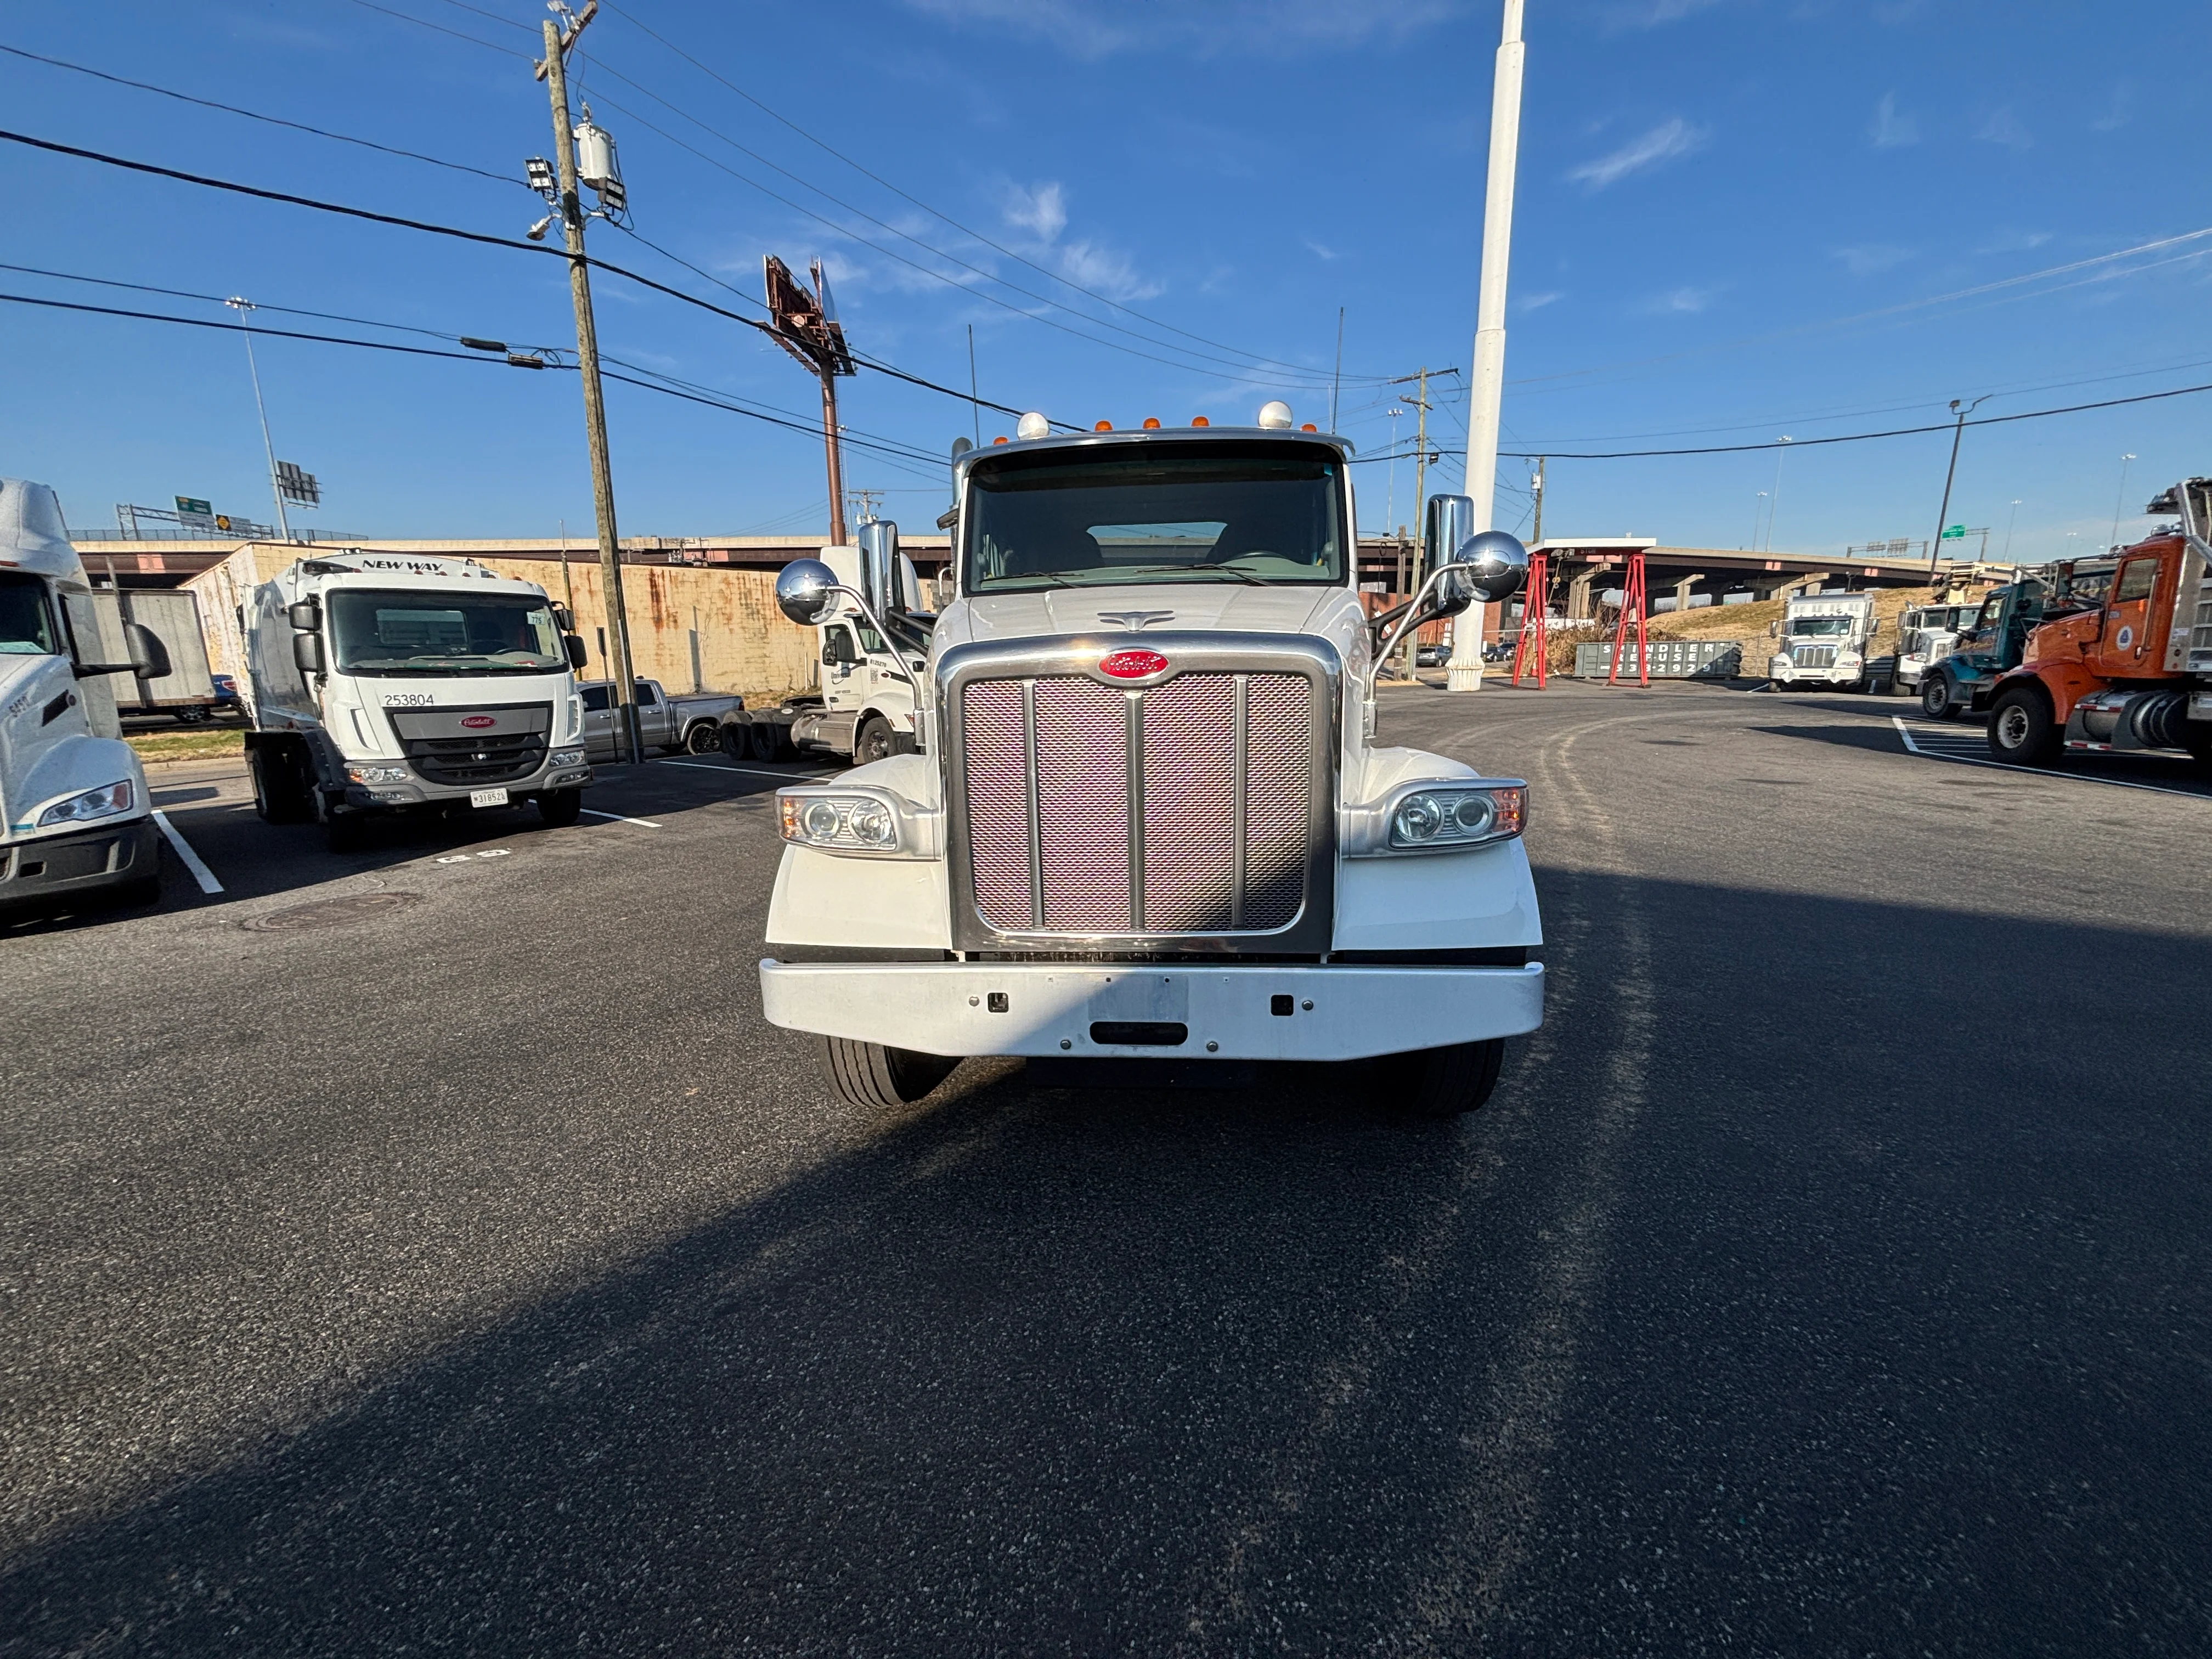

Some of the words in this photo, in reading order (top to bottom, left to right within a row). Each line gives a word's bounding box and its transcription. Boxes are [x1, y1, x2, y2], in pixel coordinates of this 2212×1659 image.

[362, 560, 404, 569] NEW
[407, 562, 443, 571] WAY
[385, 694, 434, 706] 253804
